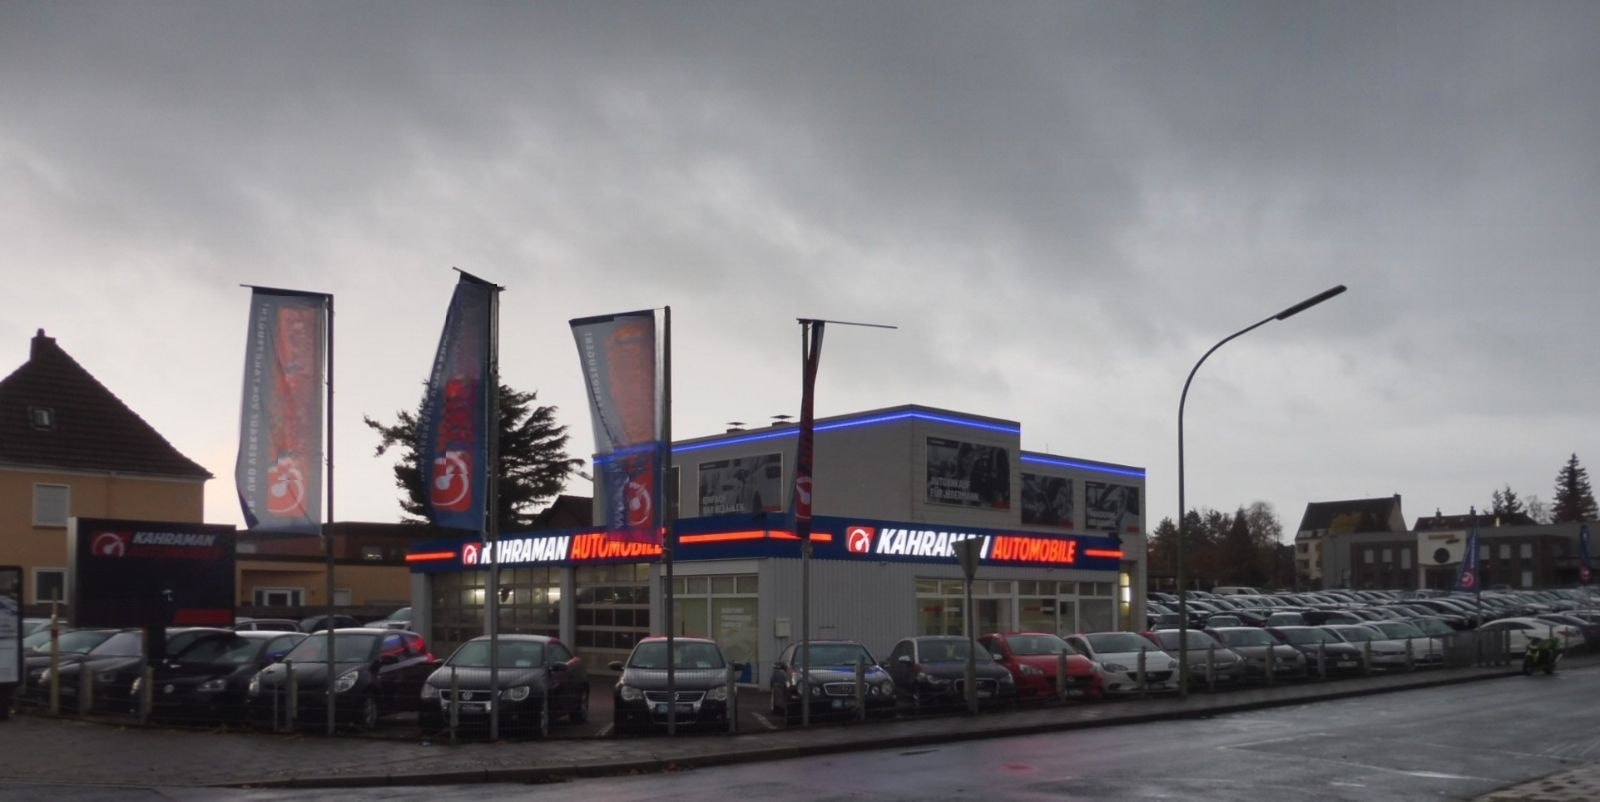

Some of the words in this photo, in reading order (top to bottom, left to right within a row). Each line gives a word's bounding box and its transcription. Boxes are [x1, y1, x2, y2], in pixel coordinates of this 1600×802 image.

[132, 531, 216, 546] KAHRAMAN
[877, 528, 991, 559] KAHRAMN
[991, 535, 1076, 562] AUTOMOBILE
